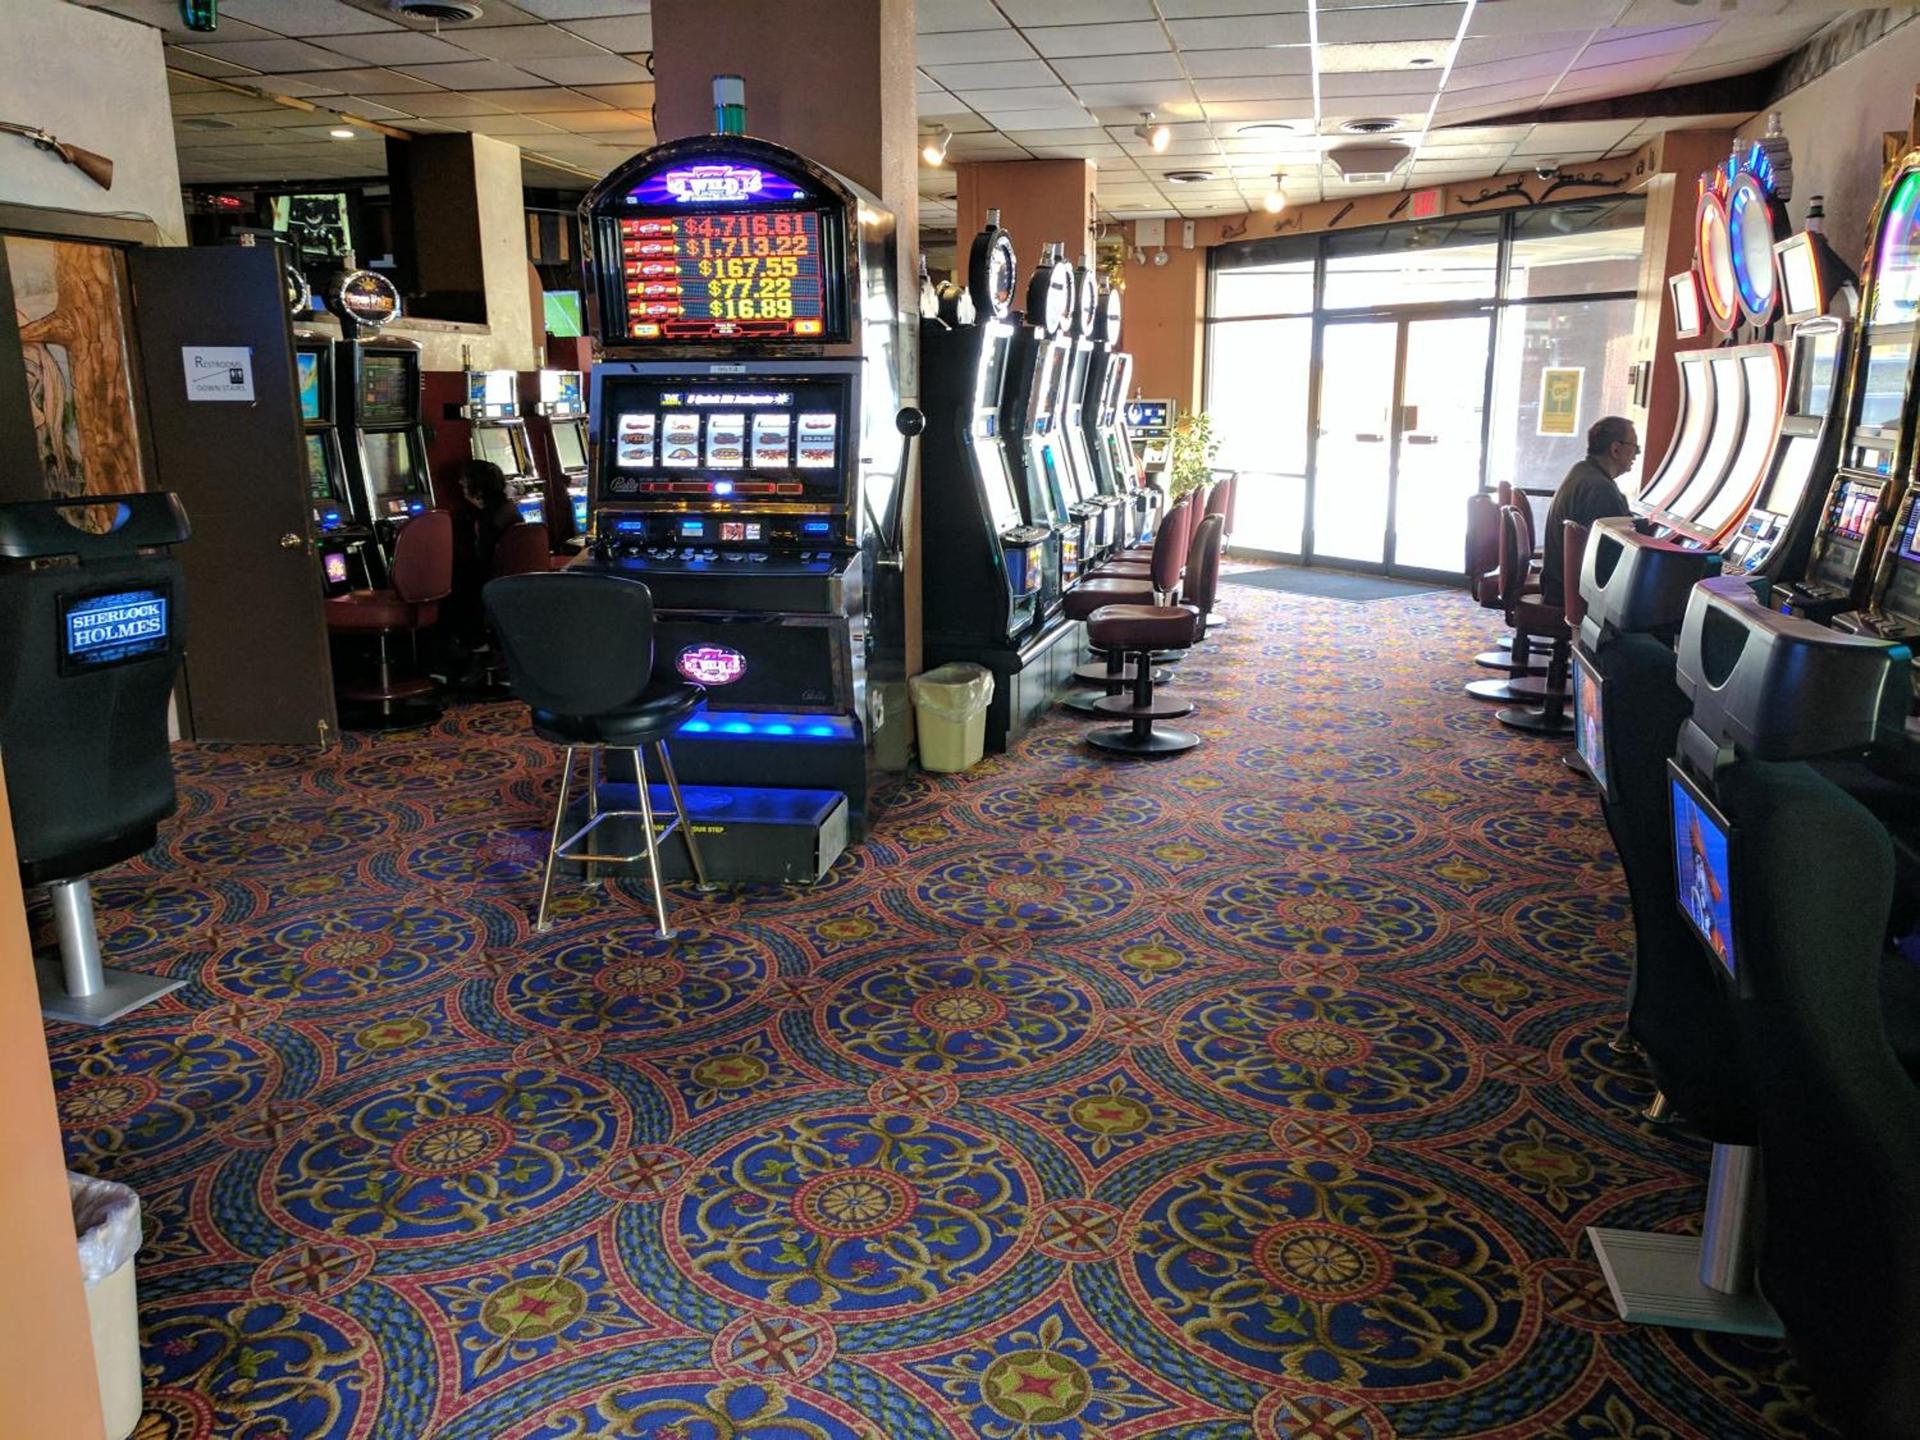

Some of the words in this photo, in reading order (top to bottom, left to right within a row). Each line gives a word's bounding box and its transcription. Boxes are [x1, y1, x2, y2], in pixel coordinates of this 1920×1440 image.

[685, 214, 805, 237] $4,716.61
[687, 235, 808, 258] $1,713.22
[699, 257, 798, 279] $167.55
[708, 278, 791, 298] $77.22
[710, 299, 793, 319] $16.89
[73, 604, 160, 629] SHERLOCK
[74, 618, 160, 647] HOLMES
